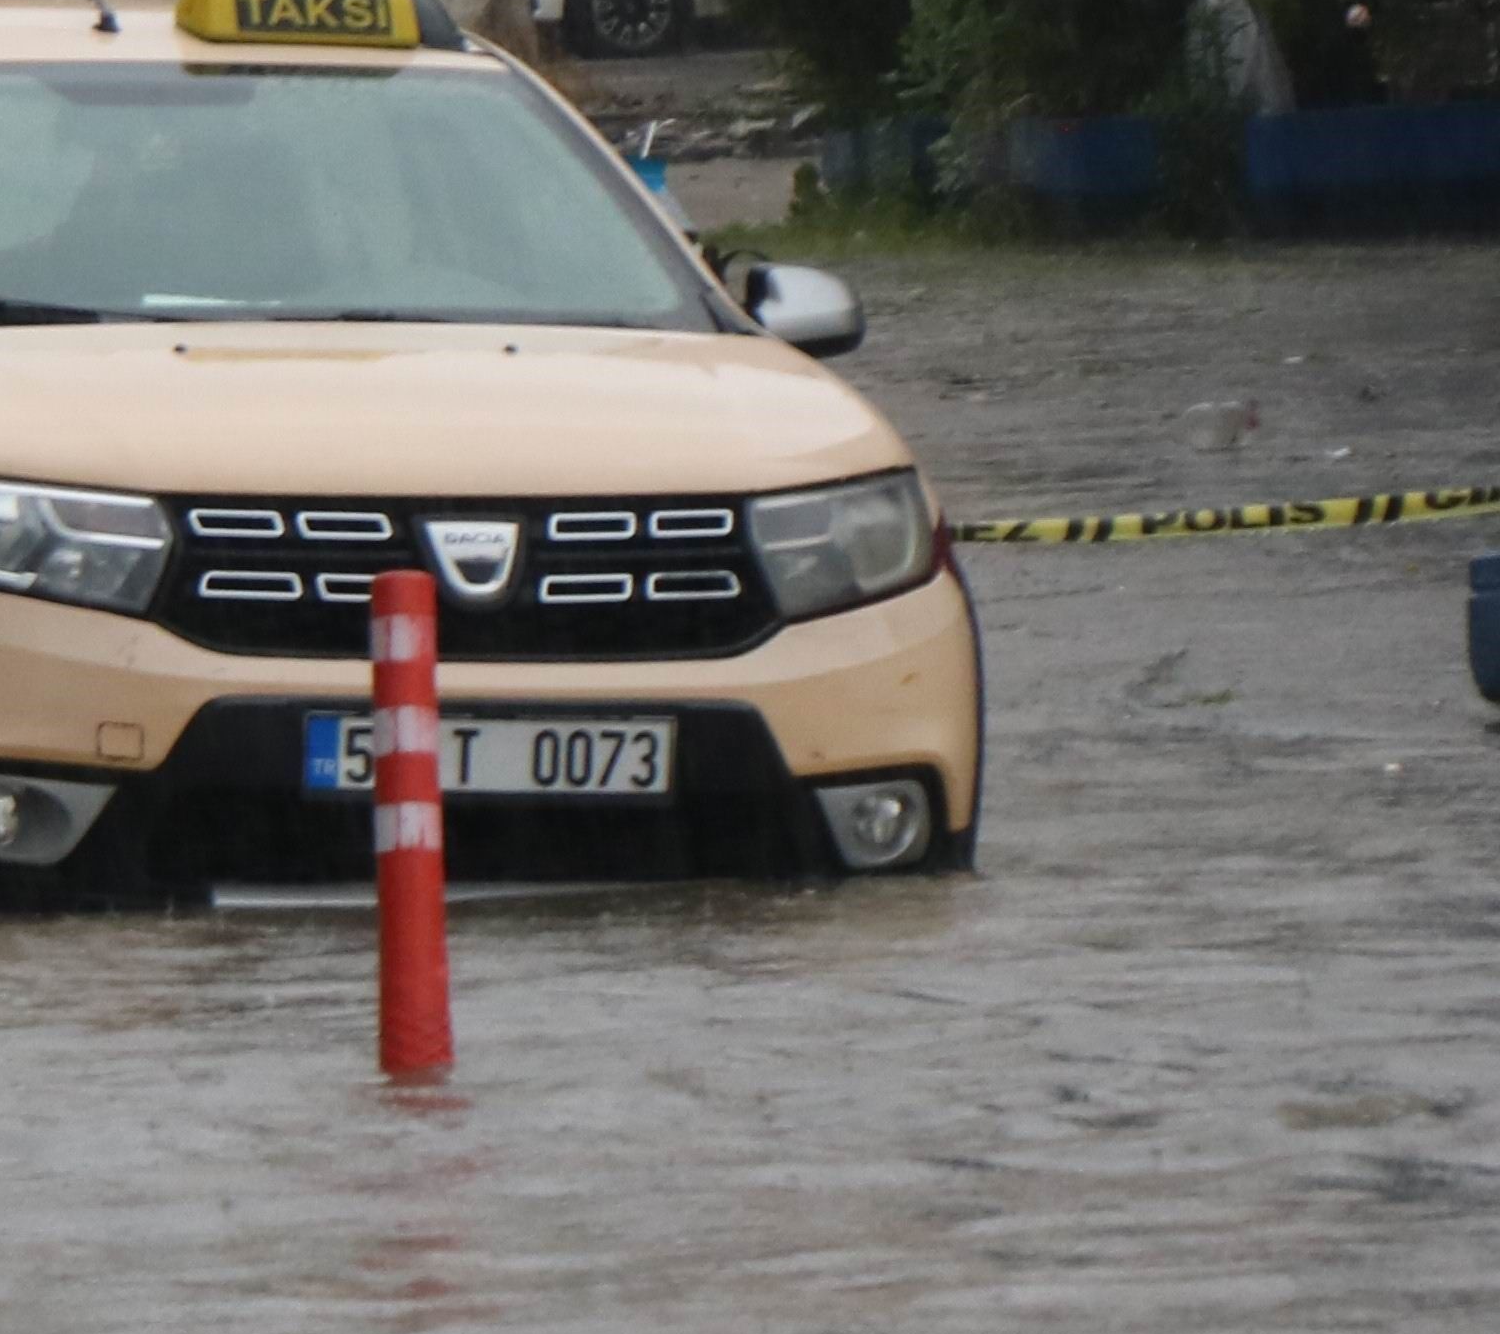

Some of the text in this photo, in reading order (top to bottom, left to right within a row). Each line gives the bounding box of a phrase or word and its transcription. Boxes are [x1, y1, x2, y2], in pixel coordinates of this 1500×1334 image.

[344, 726, 658, 788] 5 T 0073
